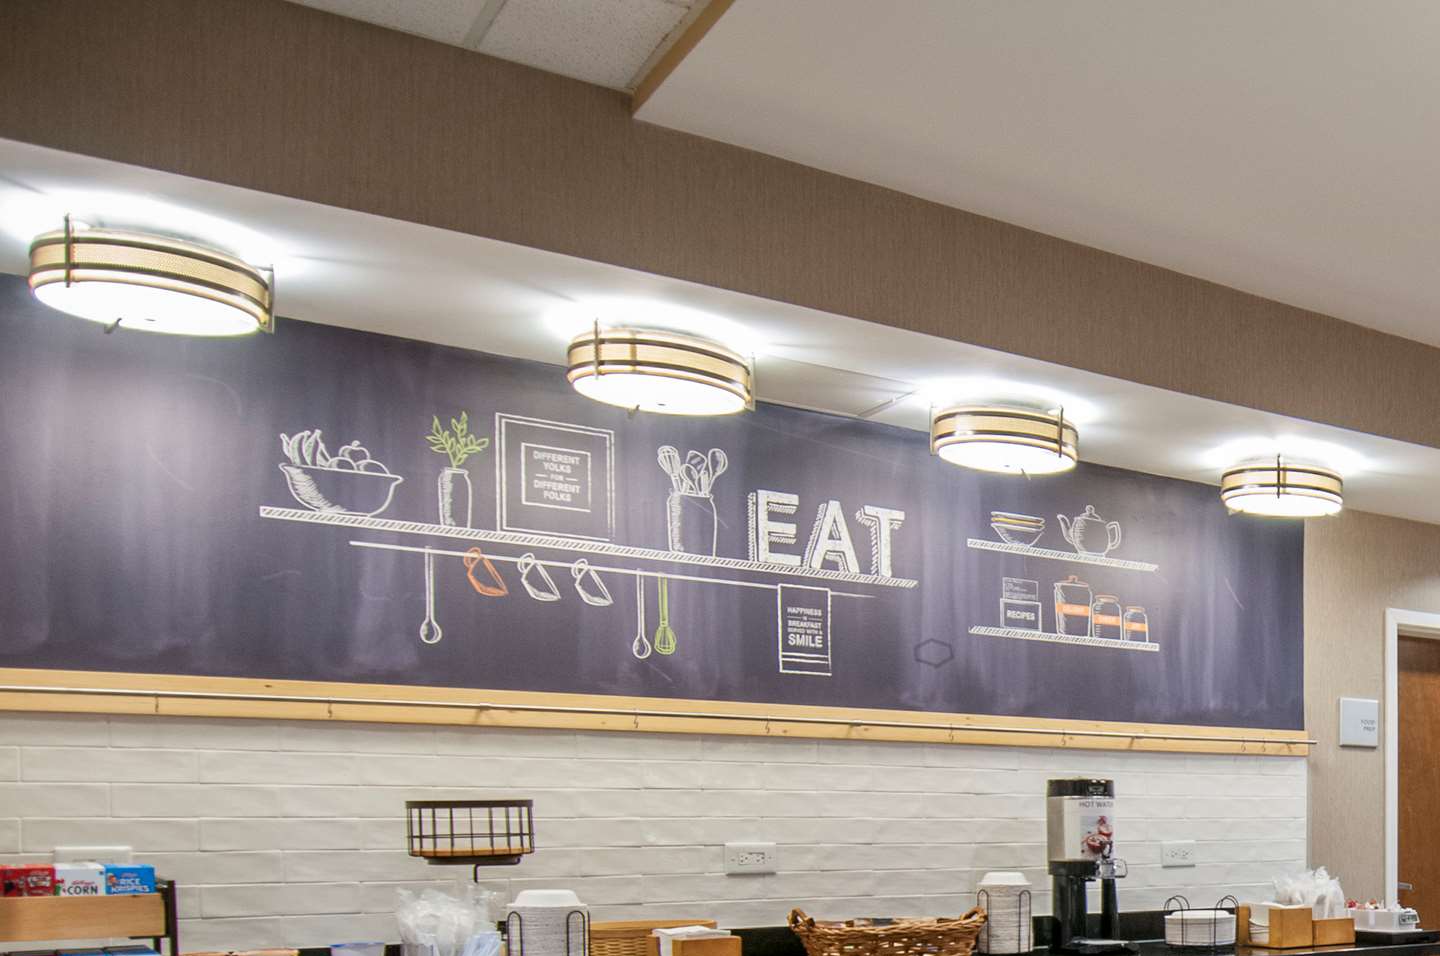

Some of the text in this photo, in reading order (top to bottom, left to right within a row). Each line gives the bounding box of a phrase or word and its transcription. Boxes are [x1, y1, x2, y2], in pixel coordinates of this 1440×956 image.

[532, 450, 580, 465] DIFFERENT
[543, 461, 572, 473] YOLKS
[533, 479, 581, 494] DIFFERENT
[749, 489, 905, 577] EAT
[788, 633, 823, 648] SMILE
[67, 885, 98, 895] CORN
